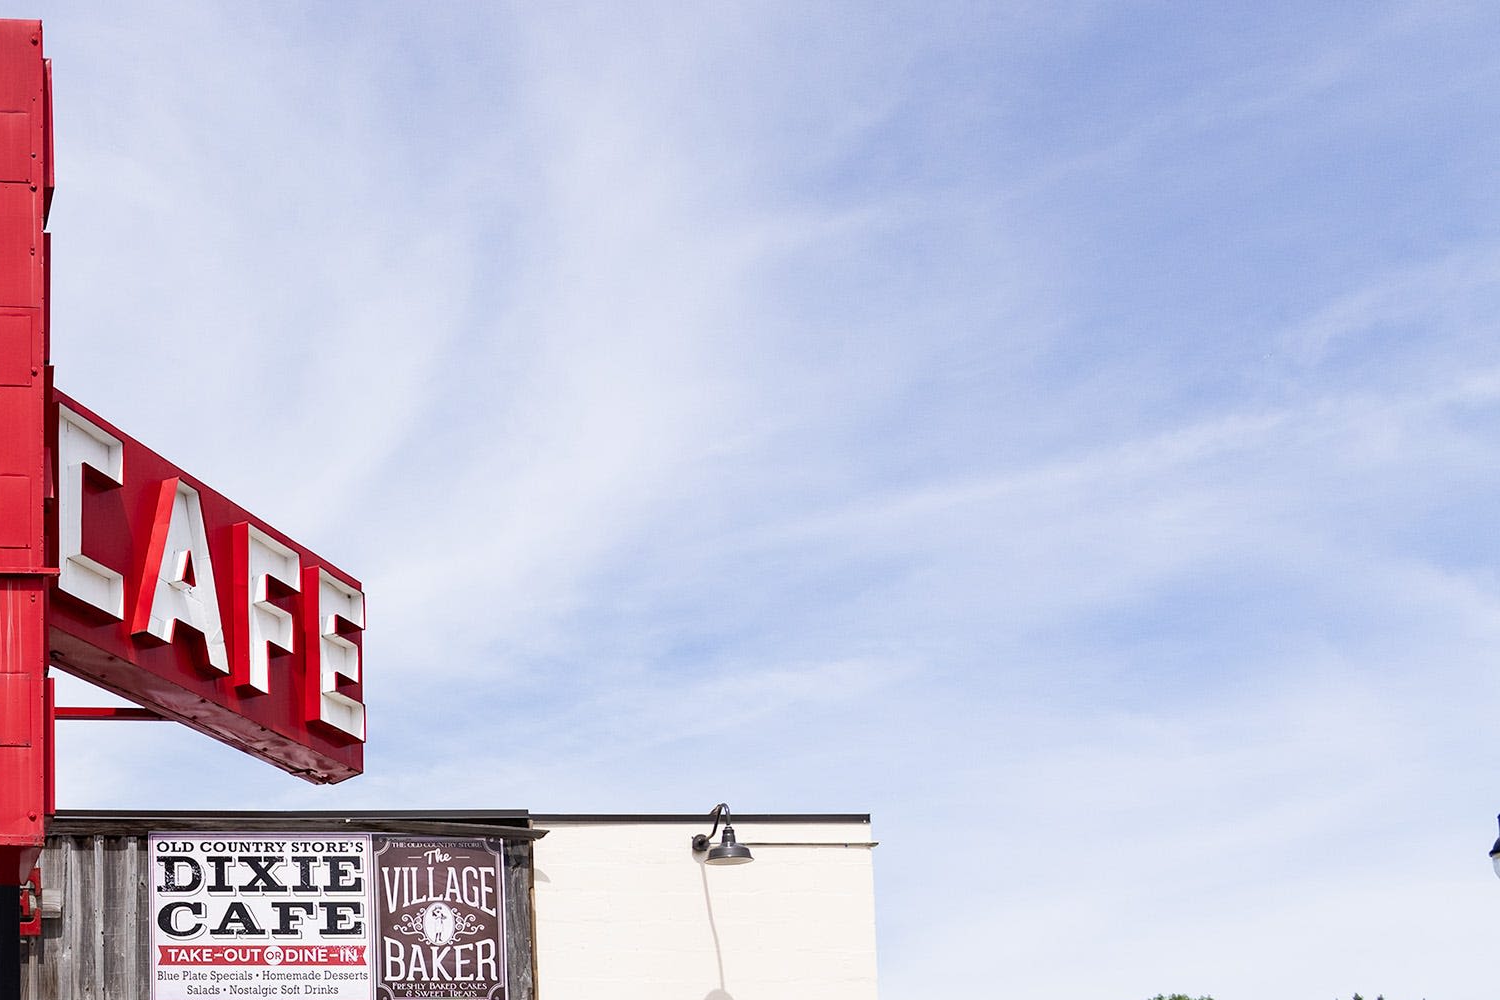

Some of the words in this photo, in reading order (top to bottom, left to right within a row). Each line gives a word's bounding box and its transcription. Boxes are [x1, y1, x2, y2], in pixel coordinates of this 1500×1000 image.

[59, 402, 366, 743] CAFE
[156, 841, 194, 853] OLD
[199, 841, 287, 853] COUNTRY
[291, 841, 364, 853] STORE'S
[424, 848, 452, 864] The
[156, 856, 364, 894] DIXIE
[381, 866, 497, 918] VILLAGE
[157, 901, 364, 938] CAFE
[167, 948, 262, 963] TAKE-OUT
[266, 951, 282, 960] OR
[285, 948, 360, 963] DINE-IN
[383, 935, 498, 982] BAKER
[157, 970, 179, 981] Blue
[182, 970, 208, 981] Plate
[210, 970, 253, 983] Specials
[262, 970, 322, 981] Homemade
[324, 970, 369, 981] Desserts
[186, 984, 220, 995] Salads
[229, 984, 278, 998] Nostalgic
[280, 984, 301, 995] Soft
[304, 984, 339, 995] Drinks
